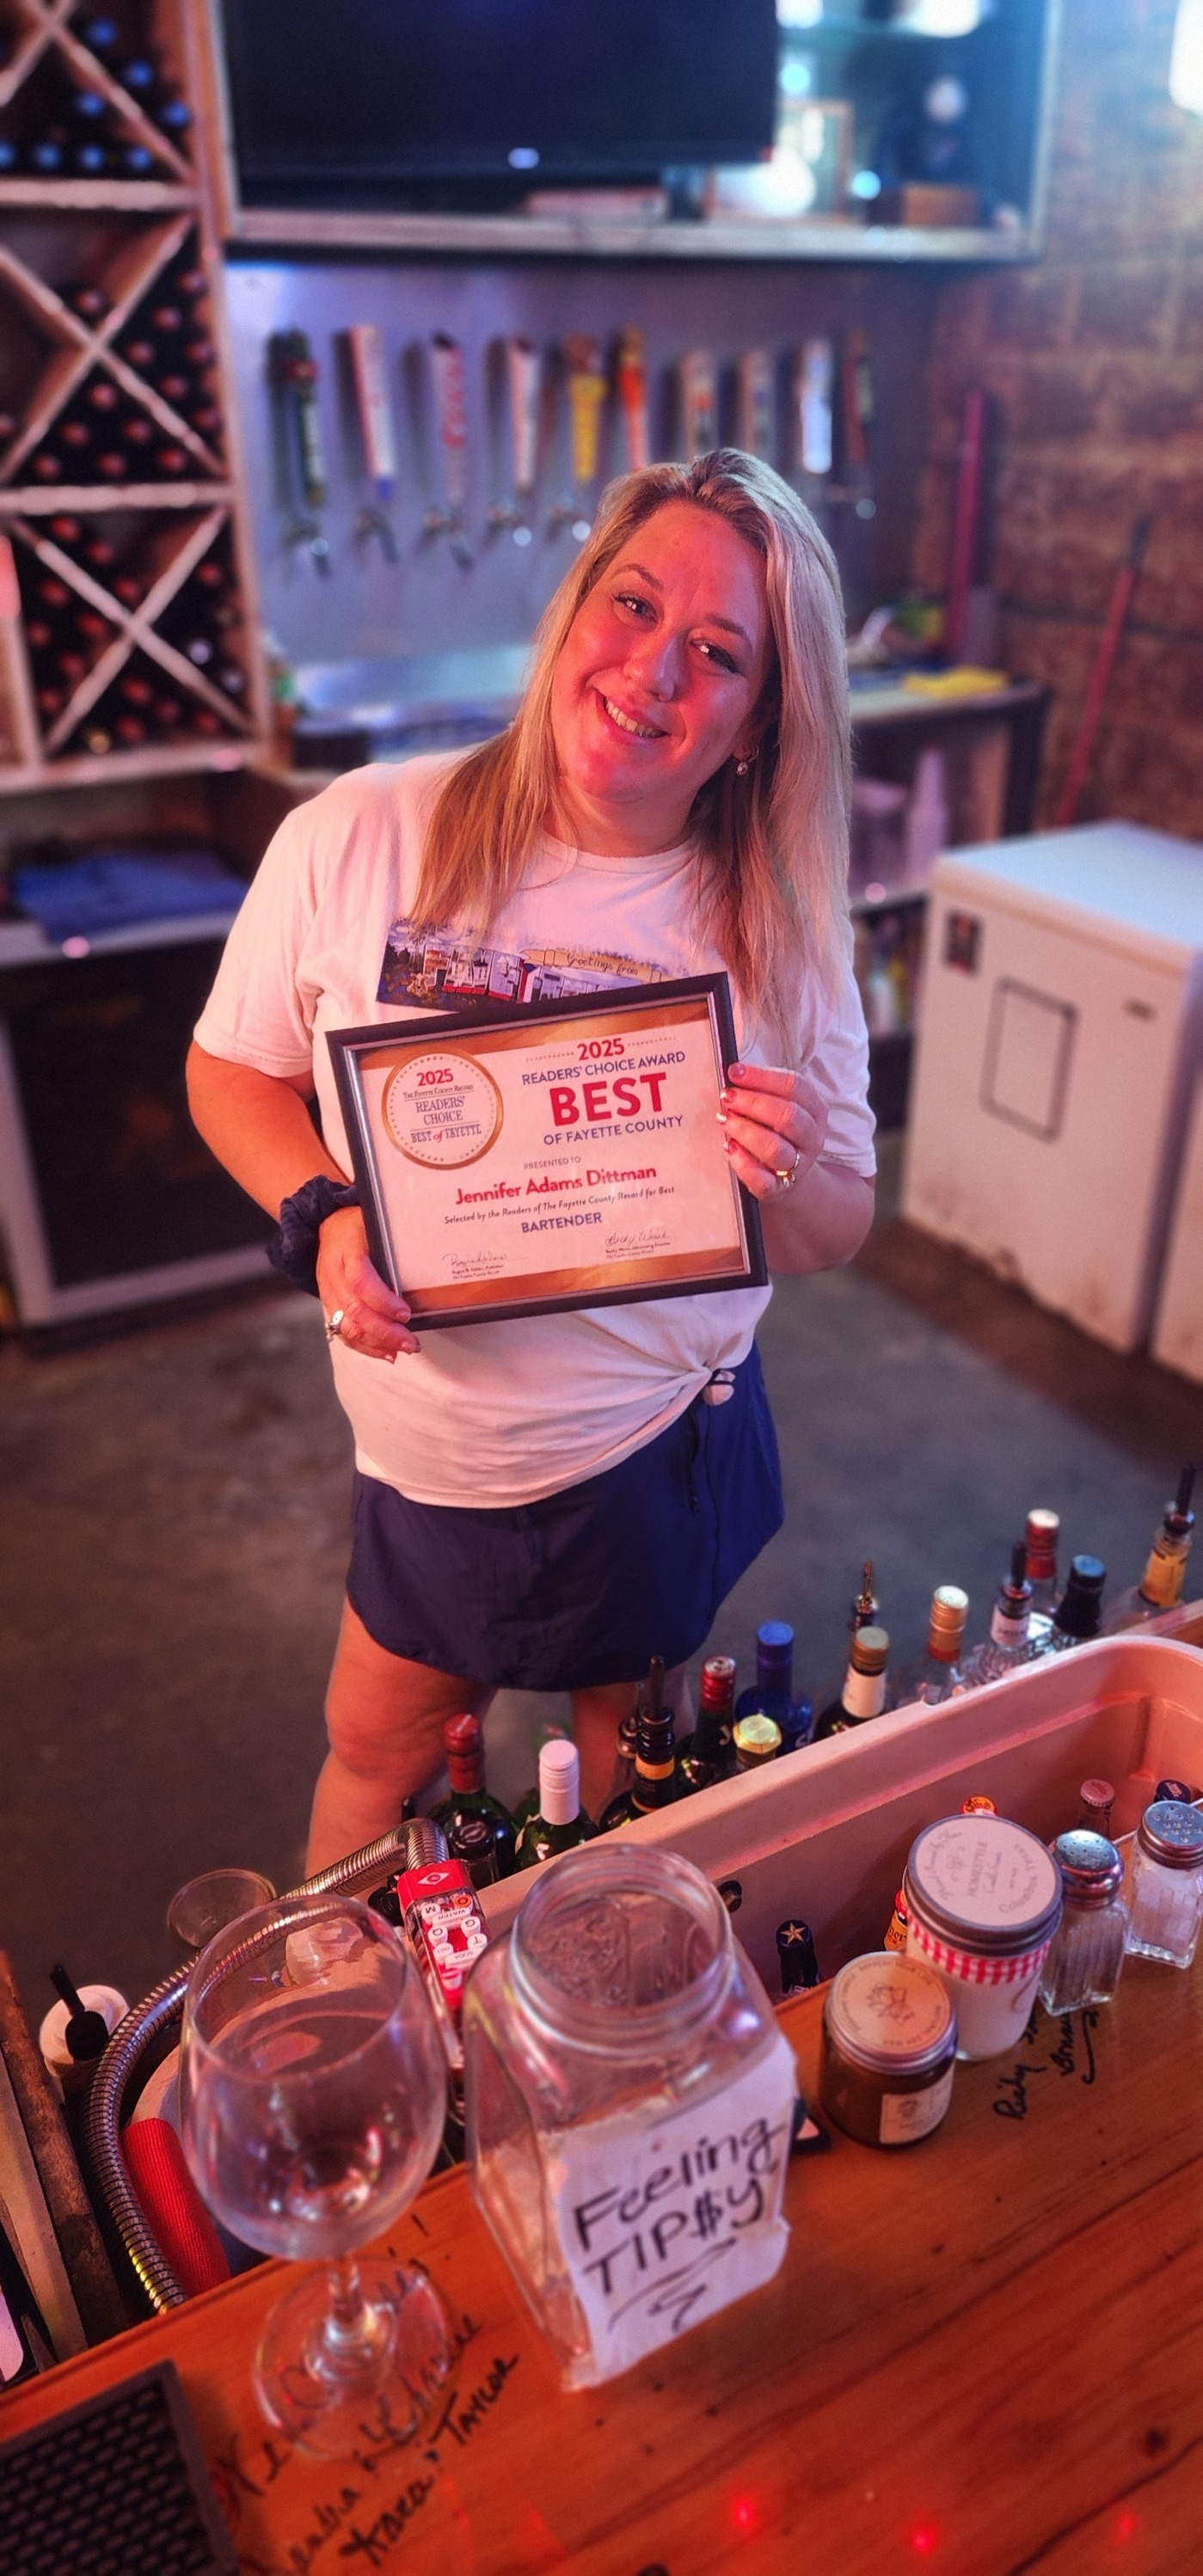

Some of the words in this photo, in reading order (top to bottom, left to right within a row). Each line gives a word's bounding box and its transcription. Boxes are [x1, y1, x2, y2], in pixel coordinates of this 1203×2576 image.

[566, 952, 613, 973] Greetings
[616, 963, 639, 977] from
[577, 1037, 626, 1062] 2025
[416, 1068, 454, 1088] 2025
[522, 1064, 583, 1086] READERS'
[585, 1057, 636, 1076] CHOICE
[637, 1051, 686, 1070] AWARD
[414, 1095, 466, 1113] READERS'
[549, 1071, 667, 1127] BEST
[423, 1109, 463, 1125] CHOICE
[410, 1130, 433, 1144] BEST
[445, 1123, 482, 1139] FAYETTE
[543, 1132, 563, 1147] OF
[566, 1124, 623, 1144] FAYETTE
[624, 1114, 684, 1134] COUNTY
[523, 1157, 569, 1171] PRESENTED
[571, 1156, 582, 1164] TO
[454, 1181, 522, 1205] Jennifer
[525, 1175, 583, 1196] Adams
[586, 1167, 658, 1187] Dittman
[444, 1211, 476, 1224] Selected
[476, 1211, 487, 1223] by
[488, 1209, 500, 1218] the
[502, 1205, 531, 1216] Readers
[533, 1202, 542, 1215] of
[543, 1200, 557, 1211] The
[558, 1198, 586, 1211] Fayette
[588, 1193, 617, 1205] County
[617, 1187, 644, 1201] Record
[645, 1188, 656, 1199] for
[658, 1185, 675, 1195] Best
[521, 1211, 603, 1234] BARTENDER
[573, 2116, 786, 2253] Feeling
[582, 2177, 766, 2297] TIP$Y
